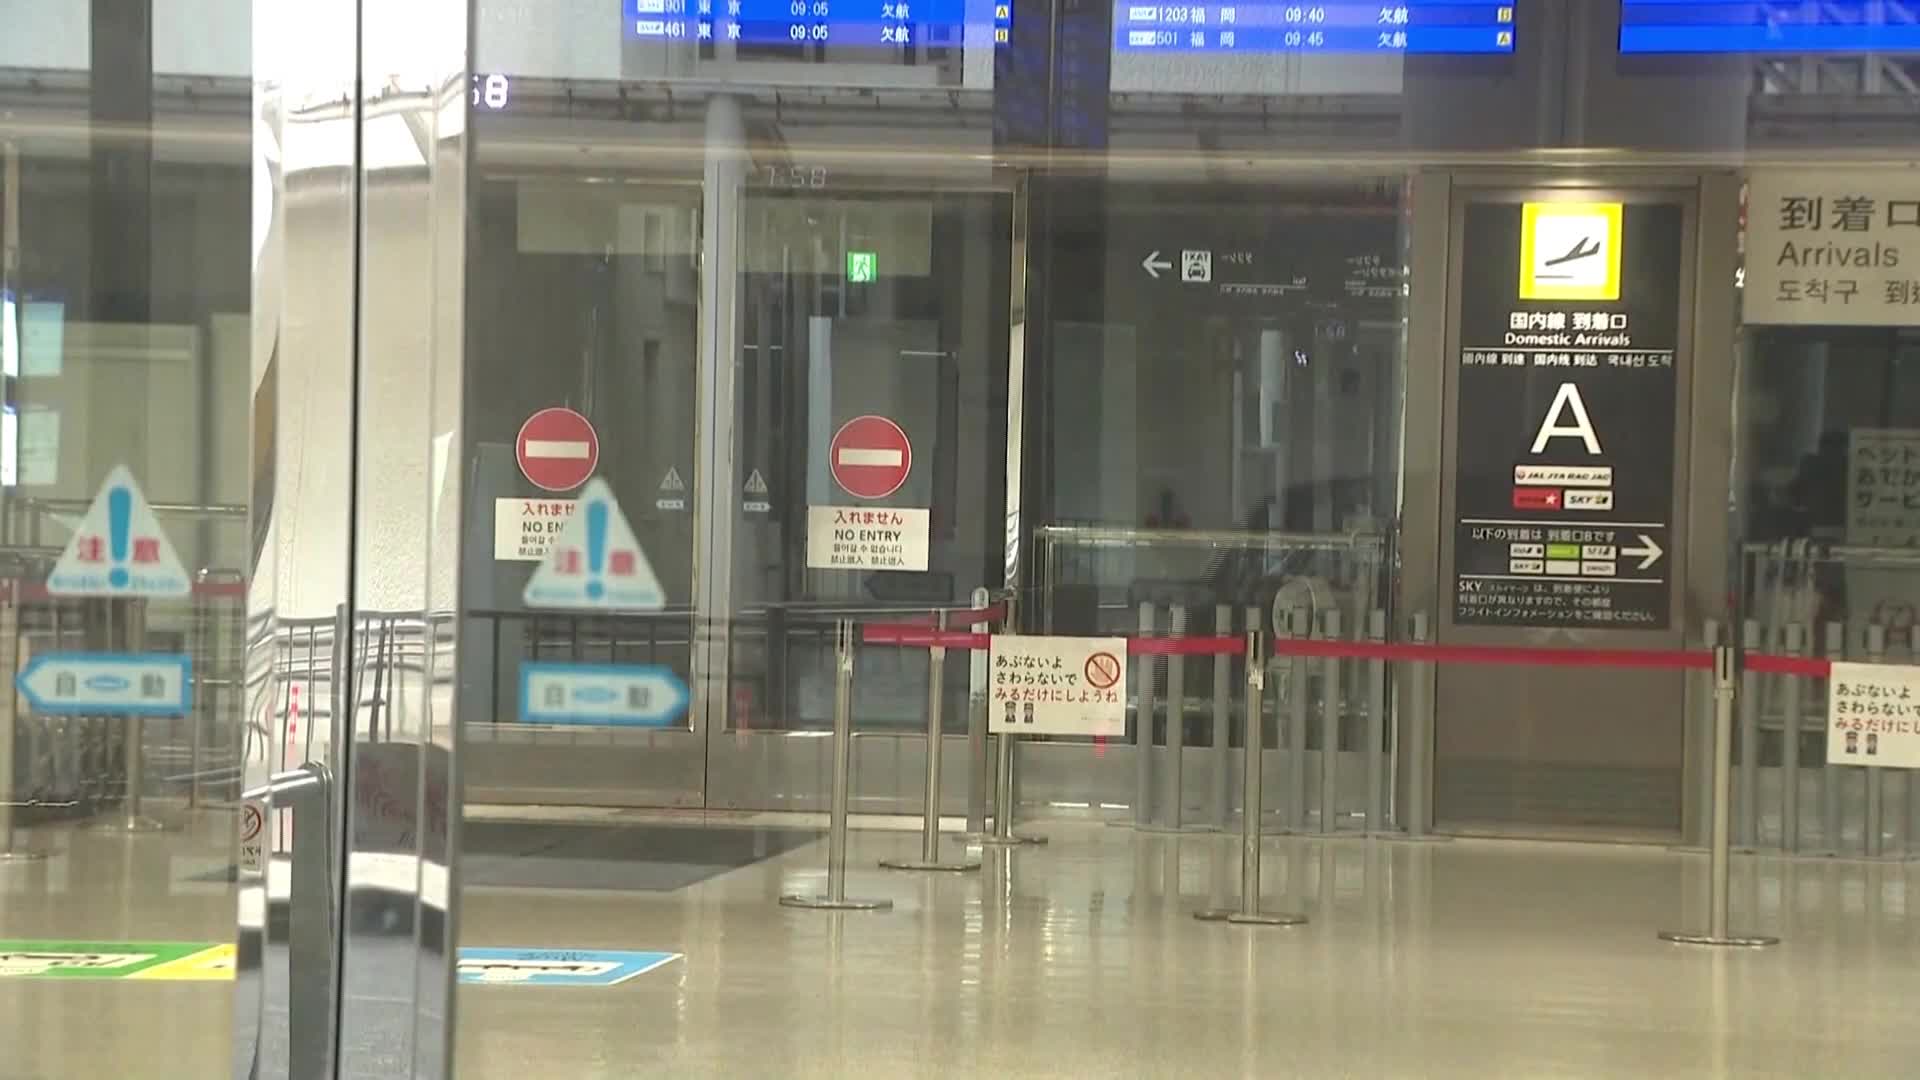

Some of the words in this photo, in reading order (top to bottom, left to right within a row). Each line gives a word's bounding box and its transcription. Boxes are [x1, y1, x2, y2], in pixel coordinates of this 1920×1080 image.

[791, 0, 828, 17] 09:05
[1285, 7, 1325, 23] 09:40
[790, 25, 828, 40] 09:05
[1779, 195, 1920, 232] 到着口
[1777, 240, 1899, 267] Arrivals
[1776, 278, 1859, 304] 도착구
[1505, 333, 1571, 346] Domestic
[1575, 333, 1631, 347] Arrivals
[1530, 383, 1602, 454] A
[1570, 495, 1592, 504] SKY
[522, 502, 575, 516] 入れませ
[834, 510, 904, 525] 入れません
[522, 521, 543, 533] NO
[834, 529, 855, 541] NO
[860, 530, 902, 542] ENTRY
[1458, 581, 1482, 593] SKY
[995, 653, 1063, 669] あぶないよ
[995, 671, 1078, 686] さわらないで
[994, 687, 1118, 703] みるだけにしようね
[1836, 683, 1911, 699] あぶないよ
